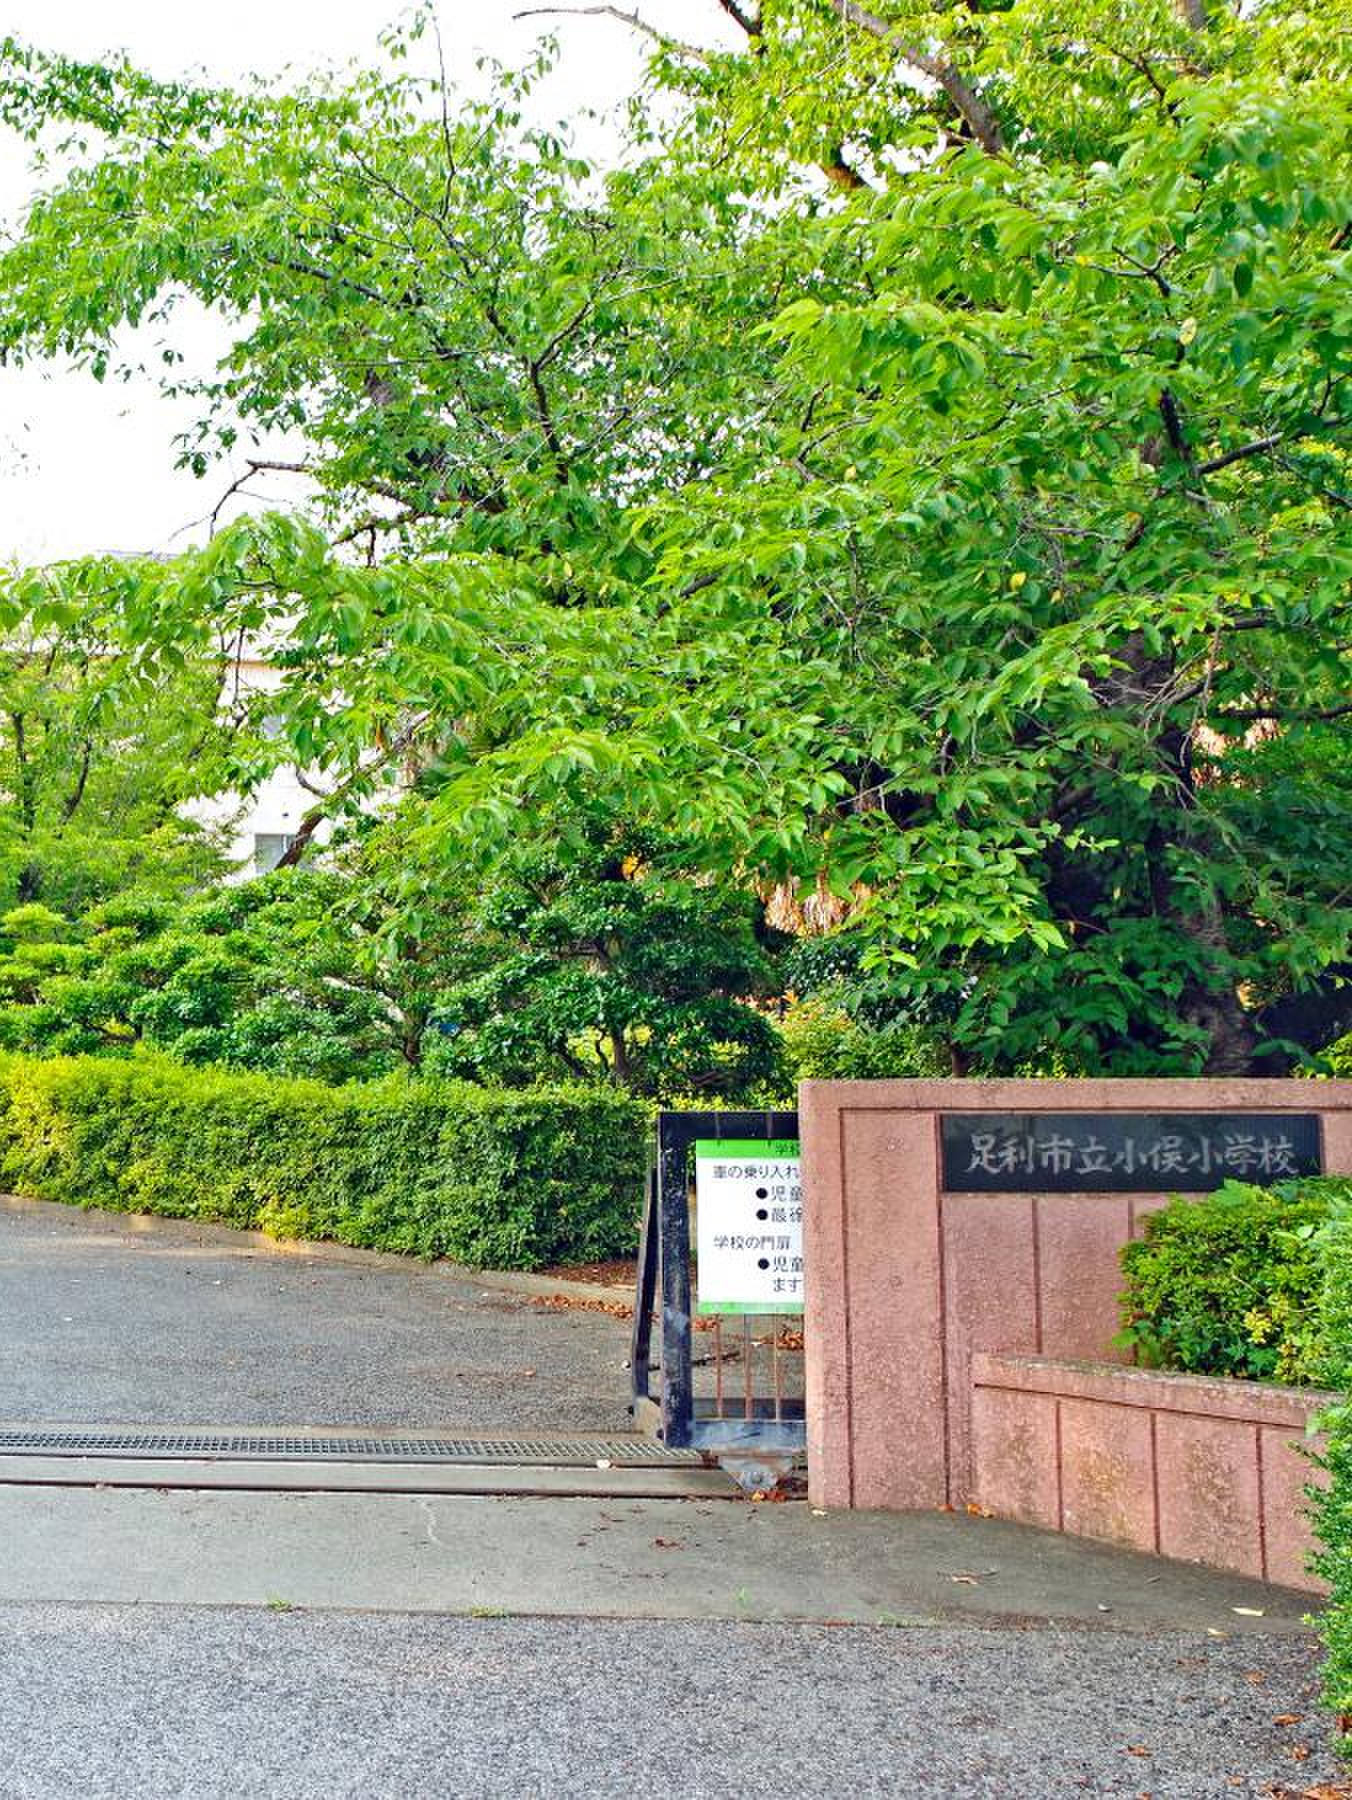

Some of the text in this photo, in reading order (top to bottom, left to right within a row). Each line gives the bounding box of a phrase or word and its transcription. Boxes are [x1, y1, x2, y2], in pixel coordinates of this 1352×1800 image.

[966, 1133, 1300, 1175] 足利市立小俣小学校
[713, 1235, 792, 1251] 学校の門扉
[773, 1276, 803, 1293] ます
